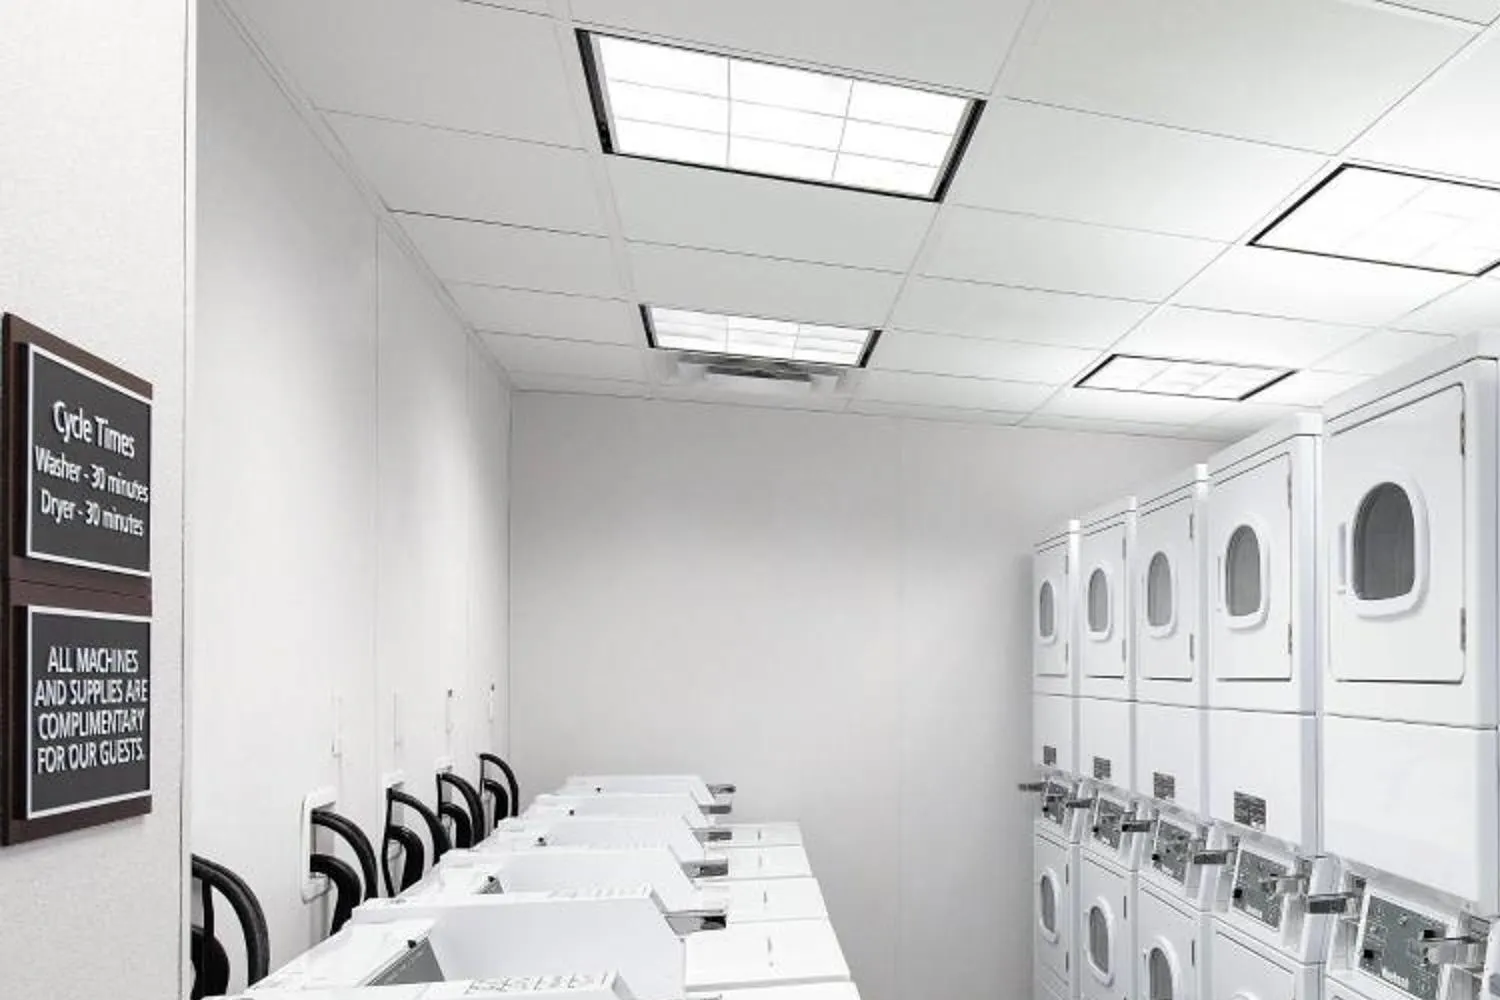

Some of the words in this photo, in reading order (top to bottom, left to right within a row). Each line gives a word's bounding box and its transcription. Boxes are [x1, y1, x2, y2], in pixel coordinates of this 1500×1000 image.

[53, 400, 93, 443] Cycle
[94, 415, 135, 459] Times
[35, 445, 82, 483] Washer
[90, 463, 105, 491] 30
[107, 471, 149, 503] minutes
[40, 487, 76, 524] Dryer
[85, 500, 101, 526] 30
[102, 505, 144, 537] minutes
[47, 645, 73, 673] ALL
[76, 647, 139, 673] MACHINES
[34, 679, 67, 706] AND
[70, 679, 123, 705] SUPPLIES
[125, 679, 148, 703] ARE
[38, 708, 145, 740] COMPLIMENTARY
[37, 744, 65, 774] FOR
[68, 741, 97, 769] OUR
[99, 737, 145, 765] GUESTS.
